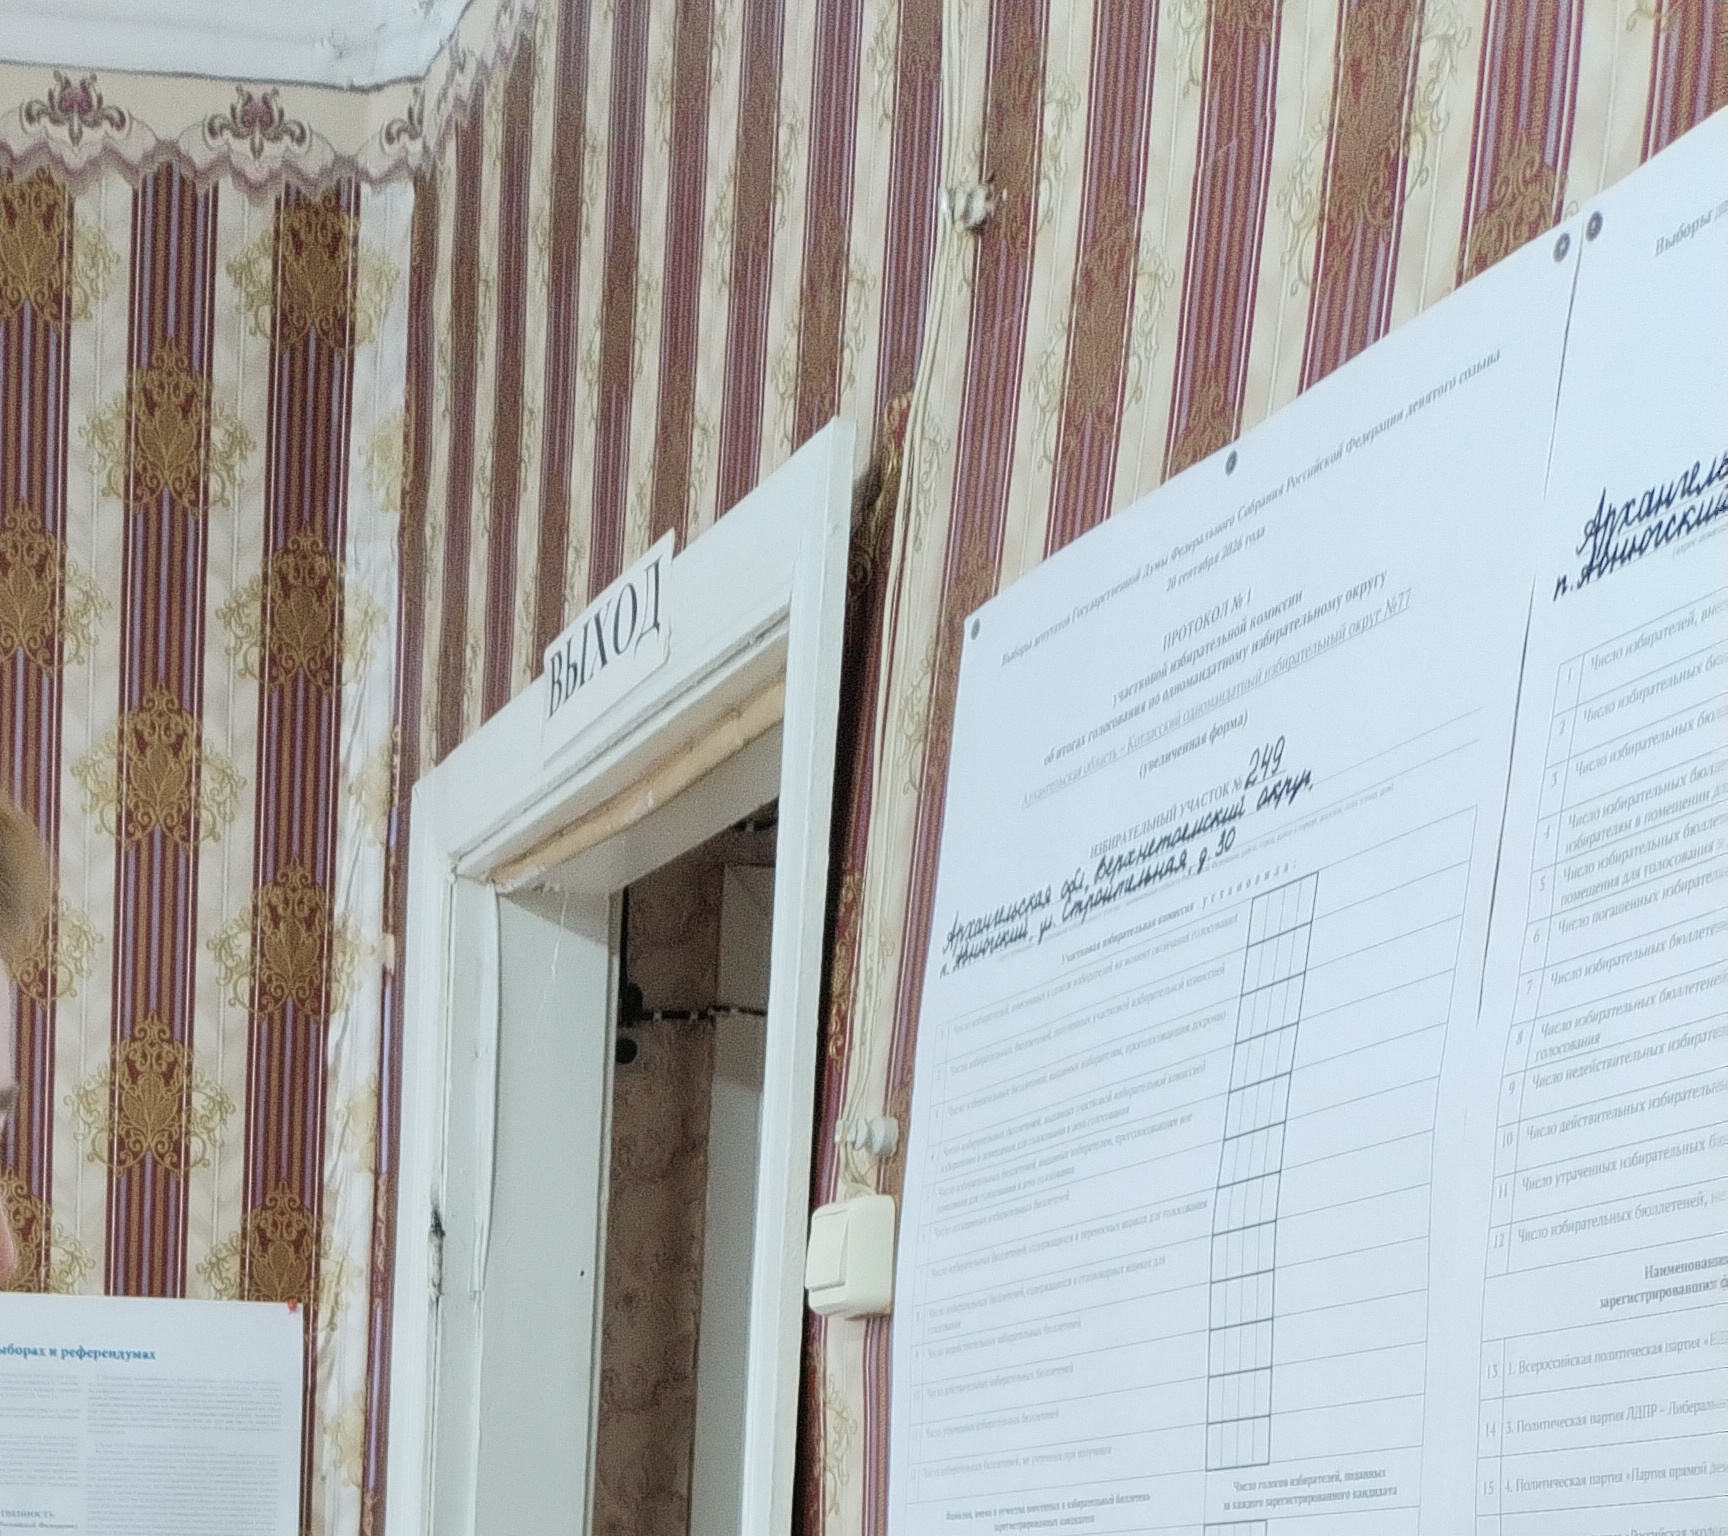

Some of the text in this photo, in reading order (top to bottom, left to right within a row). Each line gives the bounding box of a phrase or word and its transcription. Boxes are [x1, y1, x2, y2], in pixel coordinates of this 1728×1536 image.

[1654, 210, 1713, 256] Выборы
[1170, 516, 1234, 562] Федерального
[1237, 483, 1284, 523] Собрания
[1286, 444, 1343, 494] Российской
[1345, 408, 1404, 454] Федерации
[1405, 376, 1457, 420] девятого
[1458, 349, 1500, 385] созыва
[1178, 552, 1220, 586] сентября
[548, 553, 663, 720] ВЫХОД
[1112, 590, 1303, 708] участковой избирательной комиссии
[1162, 591, 1243, 652] ПРОТОКОЛ №
[1591, 647, 1623, 670] Число
[1626, 610, 1698, 656] избирателей,
[1087, 702, 1147, 746] голосования
[1162, 645, 1249, 703] одномандатному
[1251, 594, 1343, 654] избирательному
[1345, 569, 1387, 603] округу
[1127, 714, 1181, 751] Котласский
[1182, 667, 1262, 724] одномандатный
[1265, 622, 1346, 679] избирательный
[1348, 608, 1381, 634] округ
[1584, 701, 1615, 723] Число
[1618, 661, 1702, 711] избирательных
[1138, 708, 1249, 779] (увеличенная форма)
[1576, 755, 1607, 777] Число
[1609, 716, 1694, 764] избирательных
[1090, 735, 1285, 859] ИЗБИРАТЕЛЬНЫЙ УЧАСТОК 249
[1565, 819, 1632, 854] избирателям
[1644, 787, 1710, 824] помещении
[1568, 808, 1600, 830] Число
[1603, 771, 1686, 818] избирательных
[1214, 826, 1237, 858] 30
[1564, 825, 1679, 882] Число избирательных
[1560, 841, 1713, 907] помещения для голосования
[1558, 891, 1659, 934] Число погашенных
[1551, 938, 1665, 987] Число избирательных
[1541, 991, 1656, 1037] Число избирательных
[1532, 1040, 1664, 1089] Число недействительных
[1535, 1032, 1601, 1062] голосования
[1502, 1099, 1645, 1148] 10 Число действительных
[1499, 1183, 1508, 1200] 11
[1522, 1174, 1552, 1192] Число
[1554, 1157, 1618, 1189] утраченных
[1620, 1140, 1706, 1170] избирательных
[1493, 1191, 1708, 1249] 12 Число избирательных бюллетеней,
[49, 1348, 56, 1356] и
[62, 1345, 156, 1362] референдумах
[1487, 1338, 1701, 1379] 13 Всероссийская политическая партия
[1485, 1403, 1657, 1437] 14 Политическая партия ЛДПР
[1483, 1481, 1494, 1496] 15
[1515, 1472, 1586, 1492] Политическая
[1588, 1472, 1623, 1487] партия
[1626, 1467, 1666, 1482] «Партия
[1668, 1462, 1707, 1480] прямой
